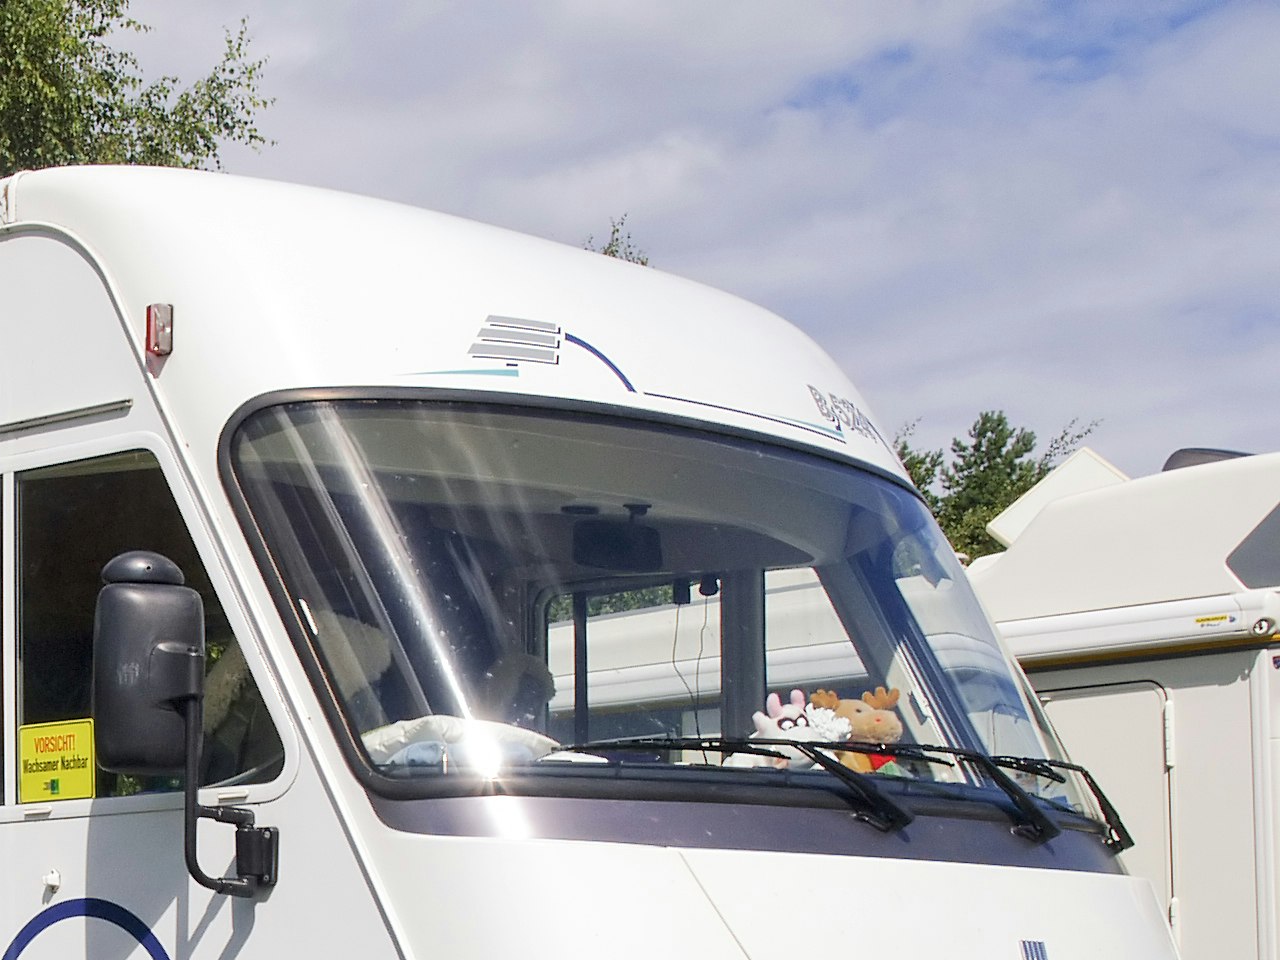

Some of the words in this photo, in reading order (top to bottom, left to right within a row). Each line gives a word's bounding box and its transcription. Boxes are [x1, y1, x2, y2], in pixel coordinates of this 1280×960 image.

[33, 733, 76, 754] VORSICHT!
[23, 758, 60, 774] Wachsamer
[60, 754, 89, 770] Nachbar
